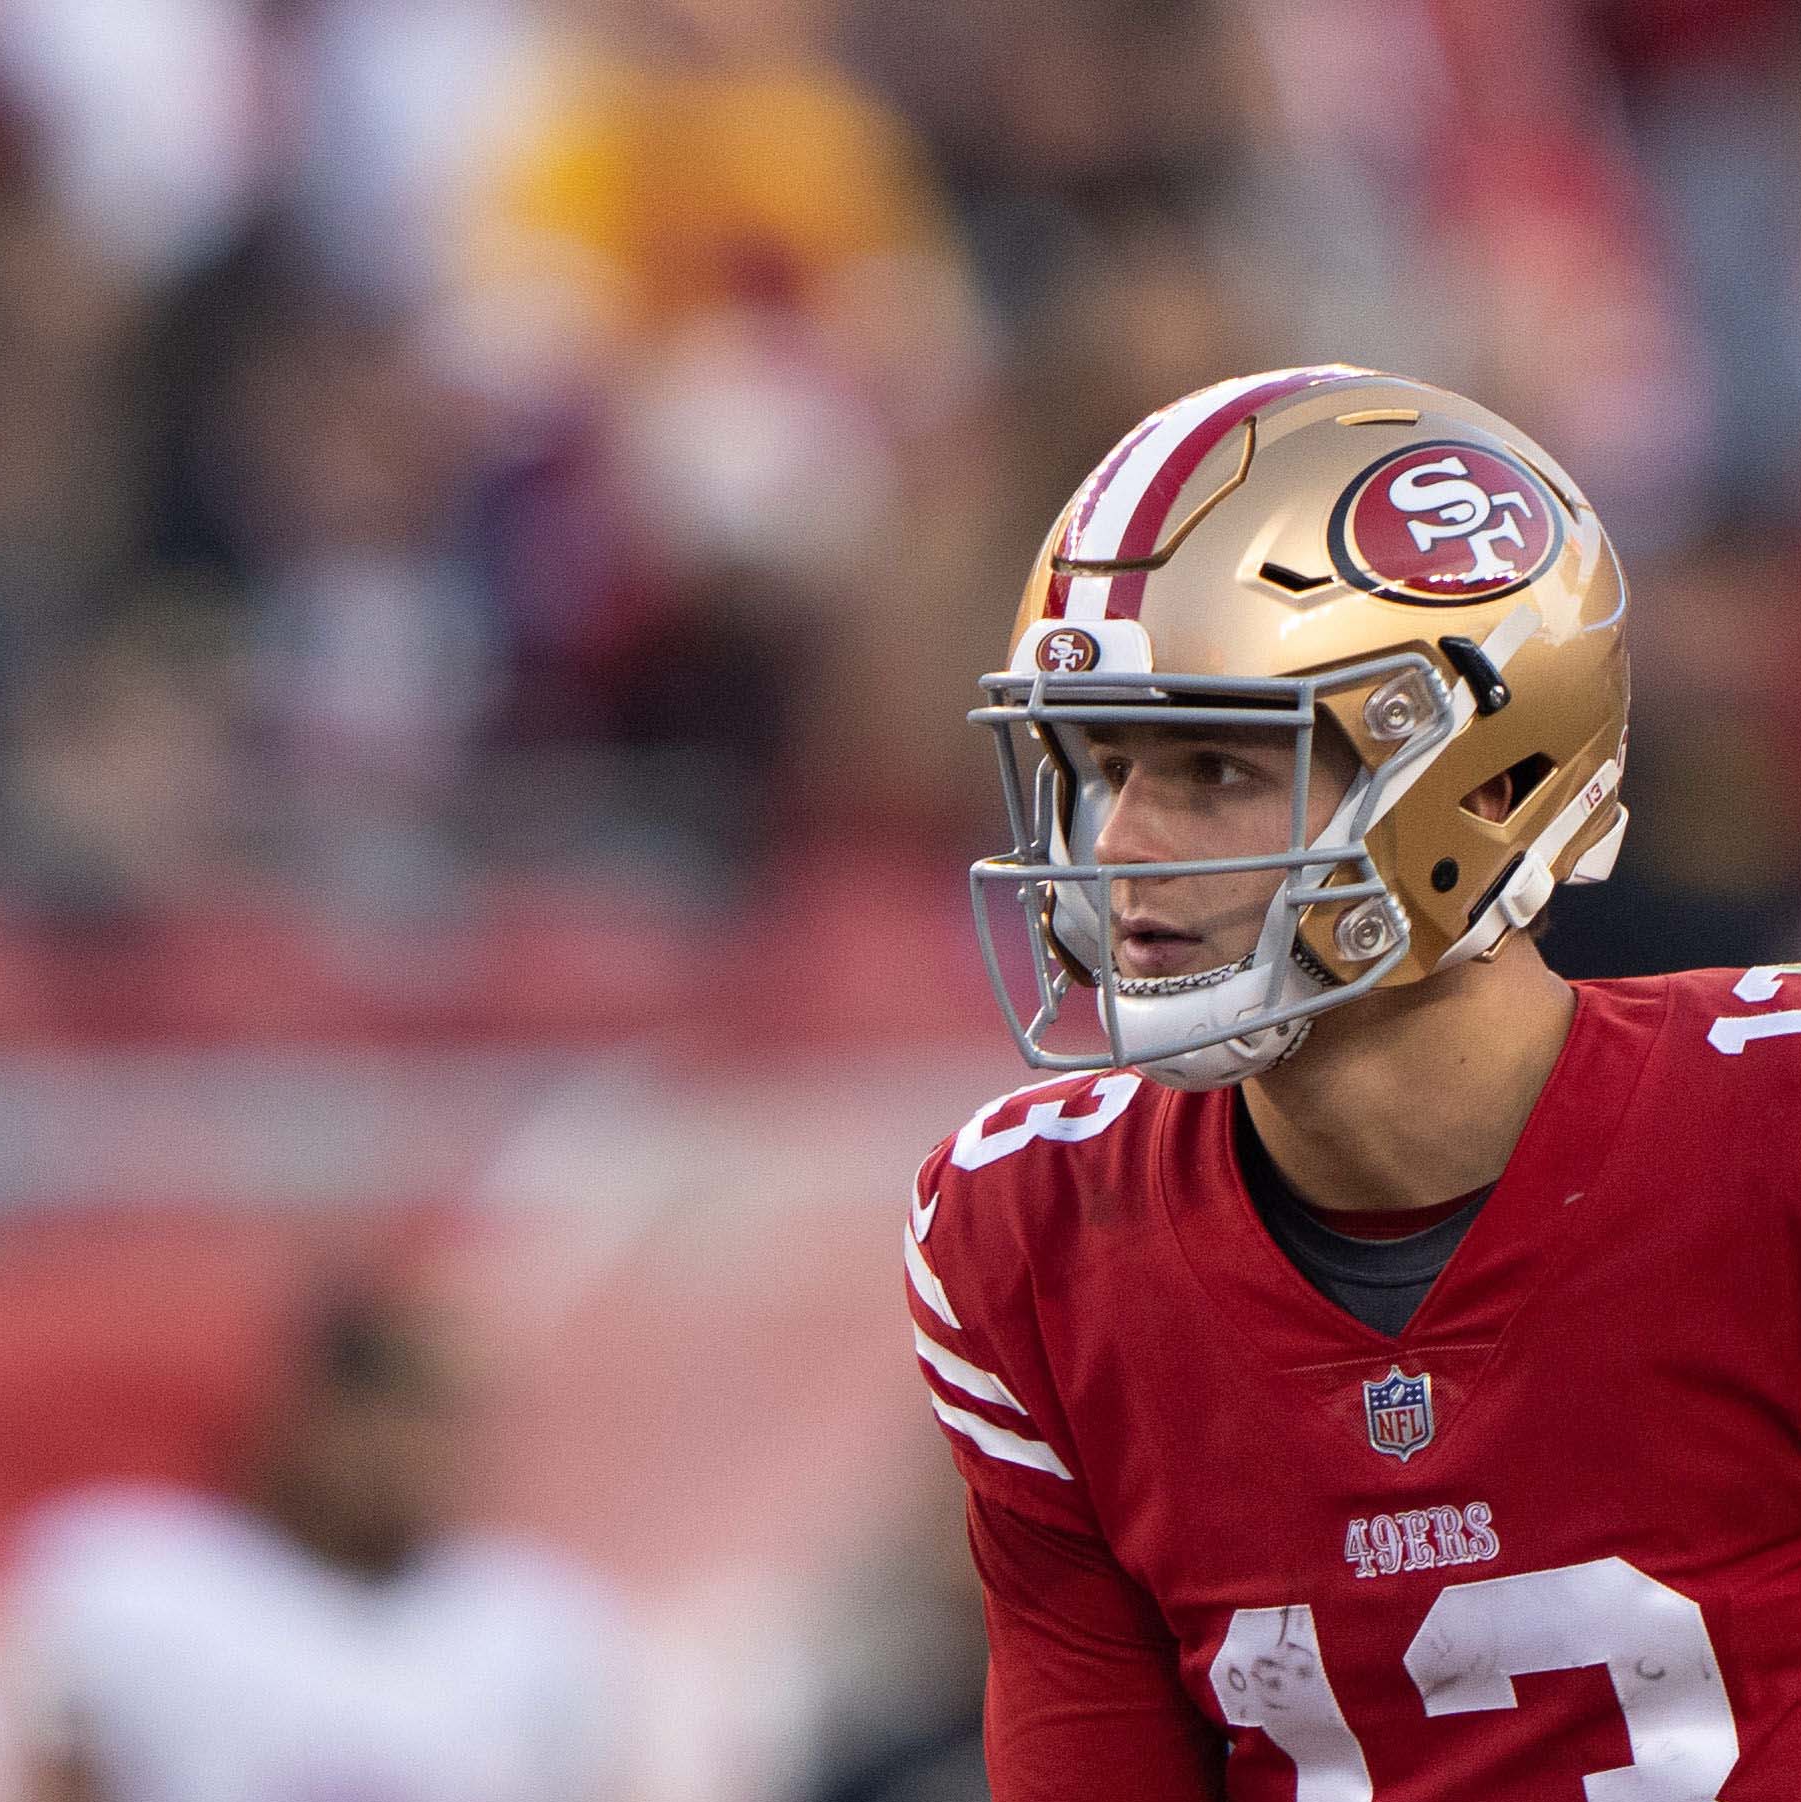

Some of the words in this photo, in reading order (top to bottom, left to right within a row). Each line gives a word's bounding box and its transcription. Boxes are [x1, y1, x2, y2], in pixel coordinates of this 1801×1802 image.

[1389, 456, 1533, 584] SF
[1049, 633, 1085, 673] SF
[1376, 1408, 1425, 1444] NFL
[1344, 1501, 1501, 1579] 49ERS
